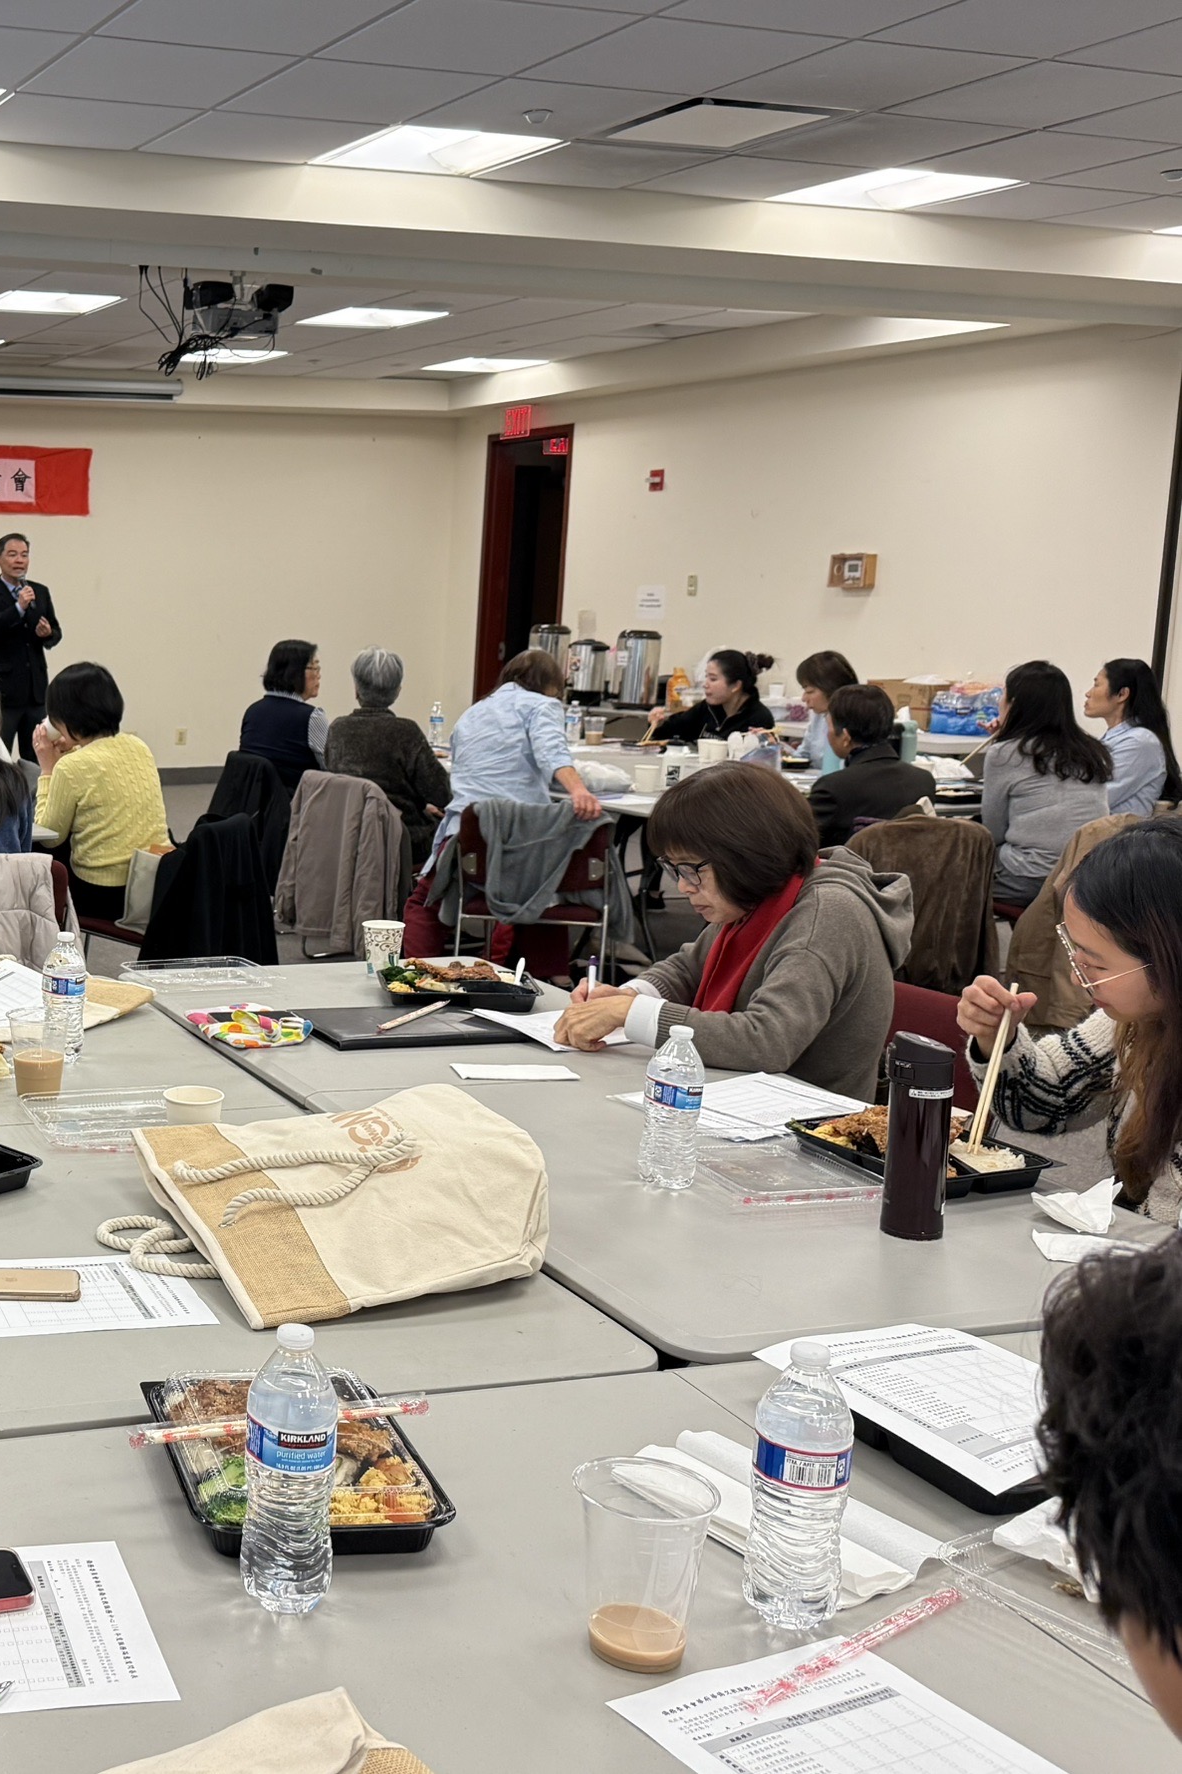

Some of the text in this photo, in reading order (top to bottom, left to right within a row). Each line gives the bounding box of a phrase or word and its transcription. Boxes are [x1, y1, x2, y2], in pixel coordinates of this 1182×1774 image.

[504, 407, 528, 436] EXIT
[280, 1433, 327, 1444] KIRKLAND
[276, 1450, 326, 1460] purified water
